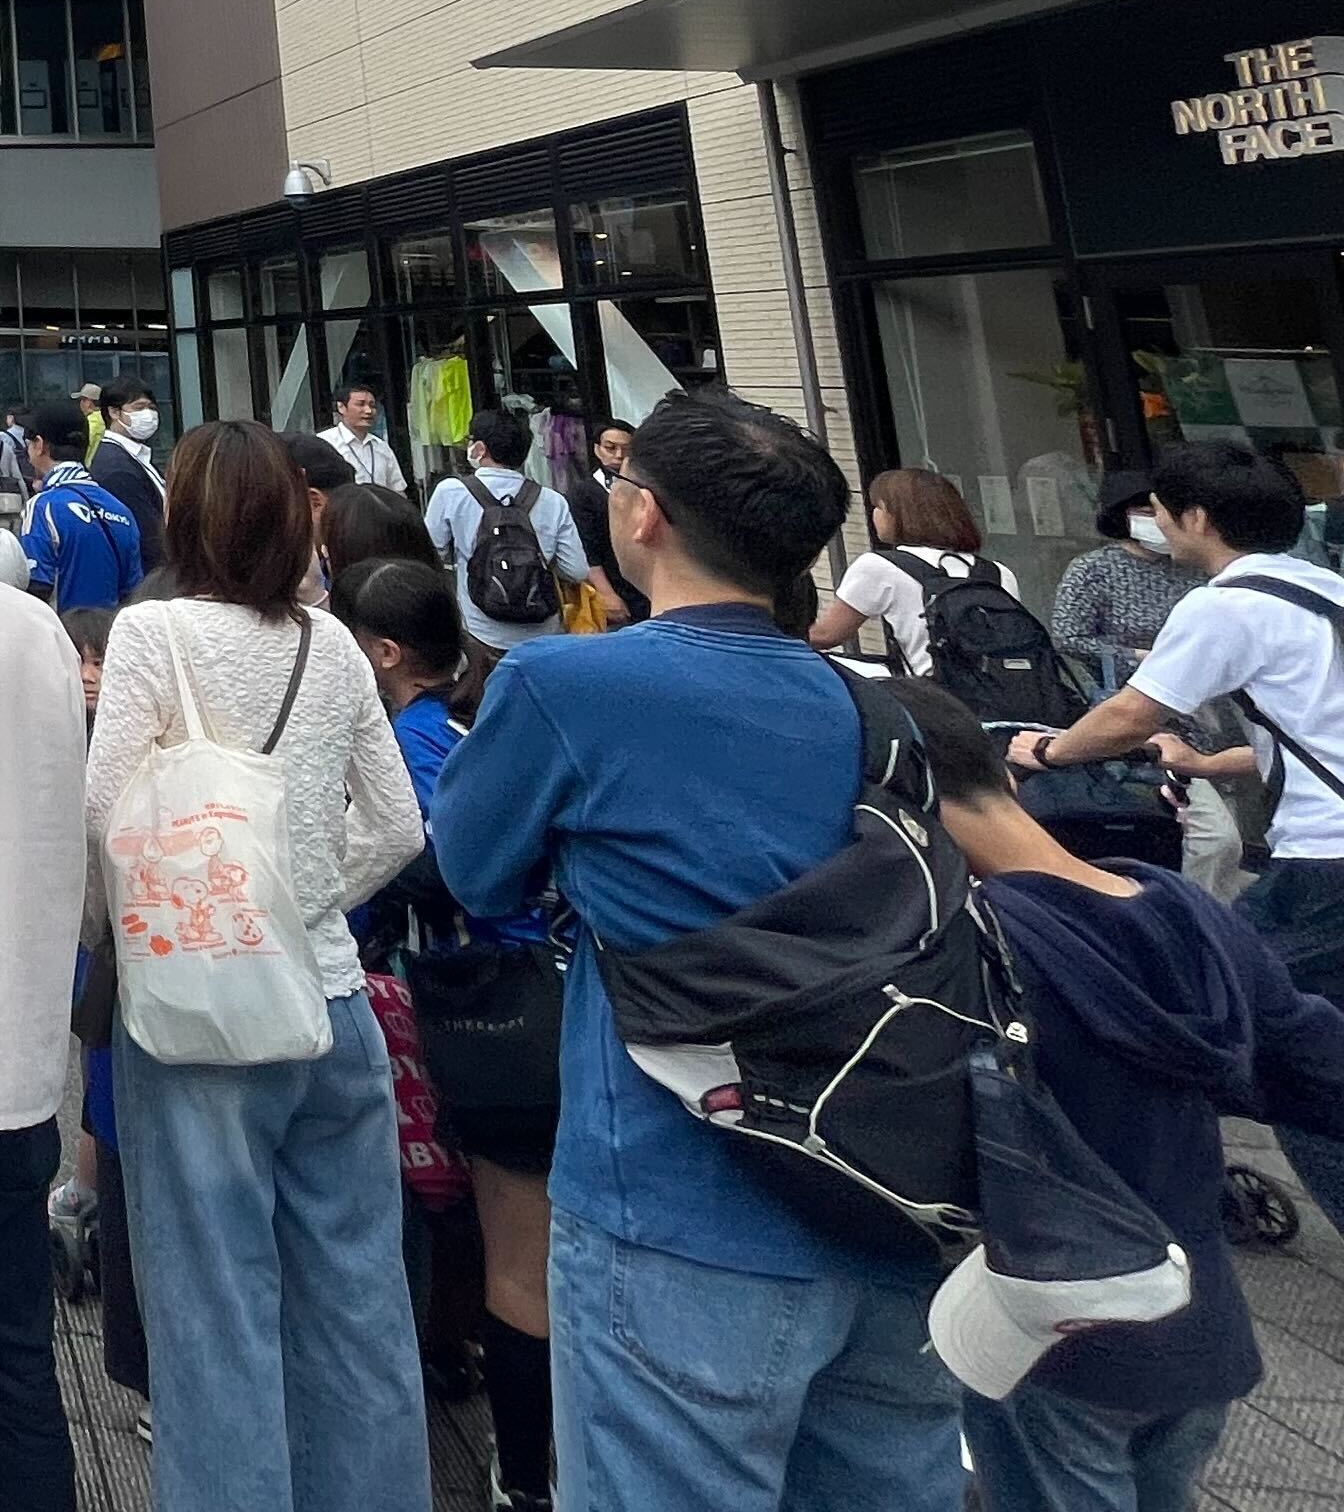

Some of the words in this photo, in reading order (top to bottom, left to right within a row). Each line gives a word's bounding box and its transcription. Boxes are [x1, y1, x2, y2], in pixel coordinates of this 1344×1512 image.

[1224, 39, 1318, 87] THE
[1171, 76, 1328, 135] NORTH
[1219, 117, 1336, 165] FACE
